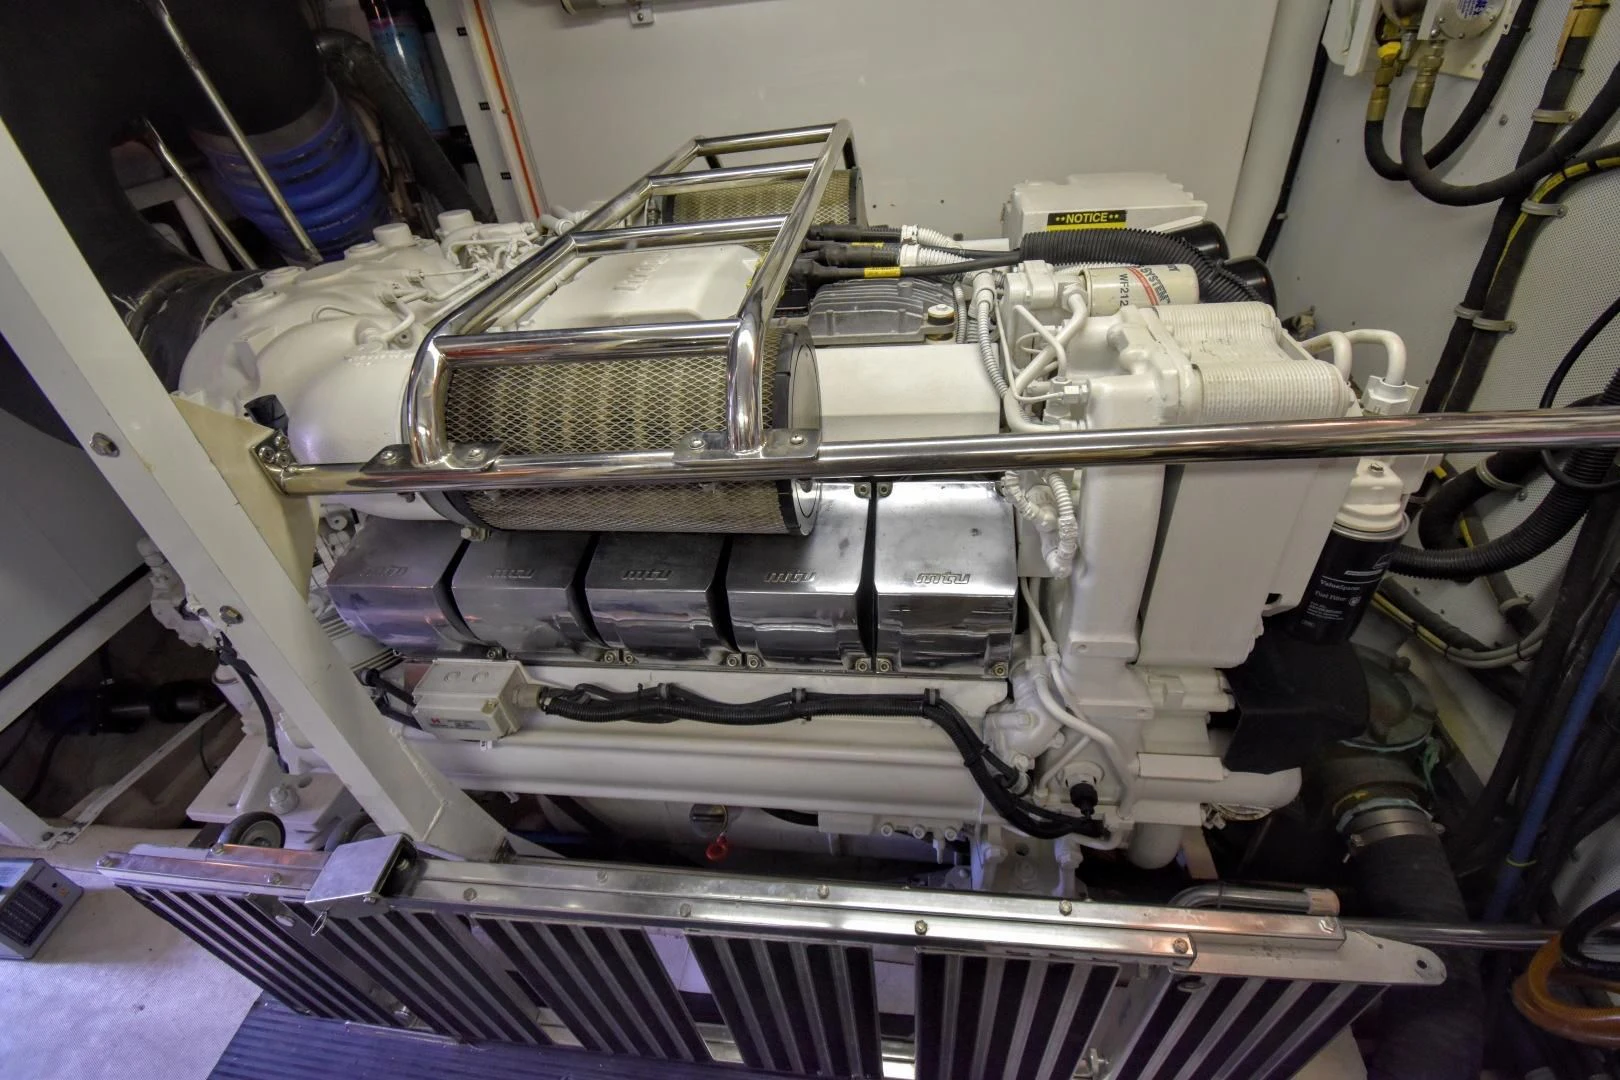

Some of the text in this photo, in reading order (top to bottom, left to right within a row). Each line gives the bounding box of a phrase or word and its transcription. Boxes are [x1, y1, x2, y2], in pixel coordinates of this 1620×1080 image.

[1066, 212, 1108, 223] NOTICE
[765, 571, 817, 583] mtu
[914, 572, 970, 584] mtu
